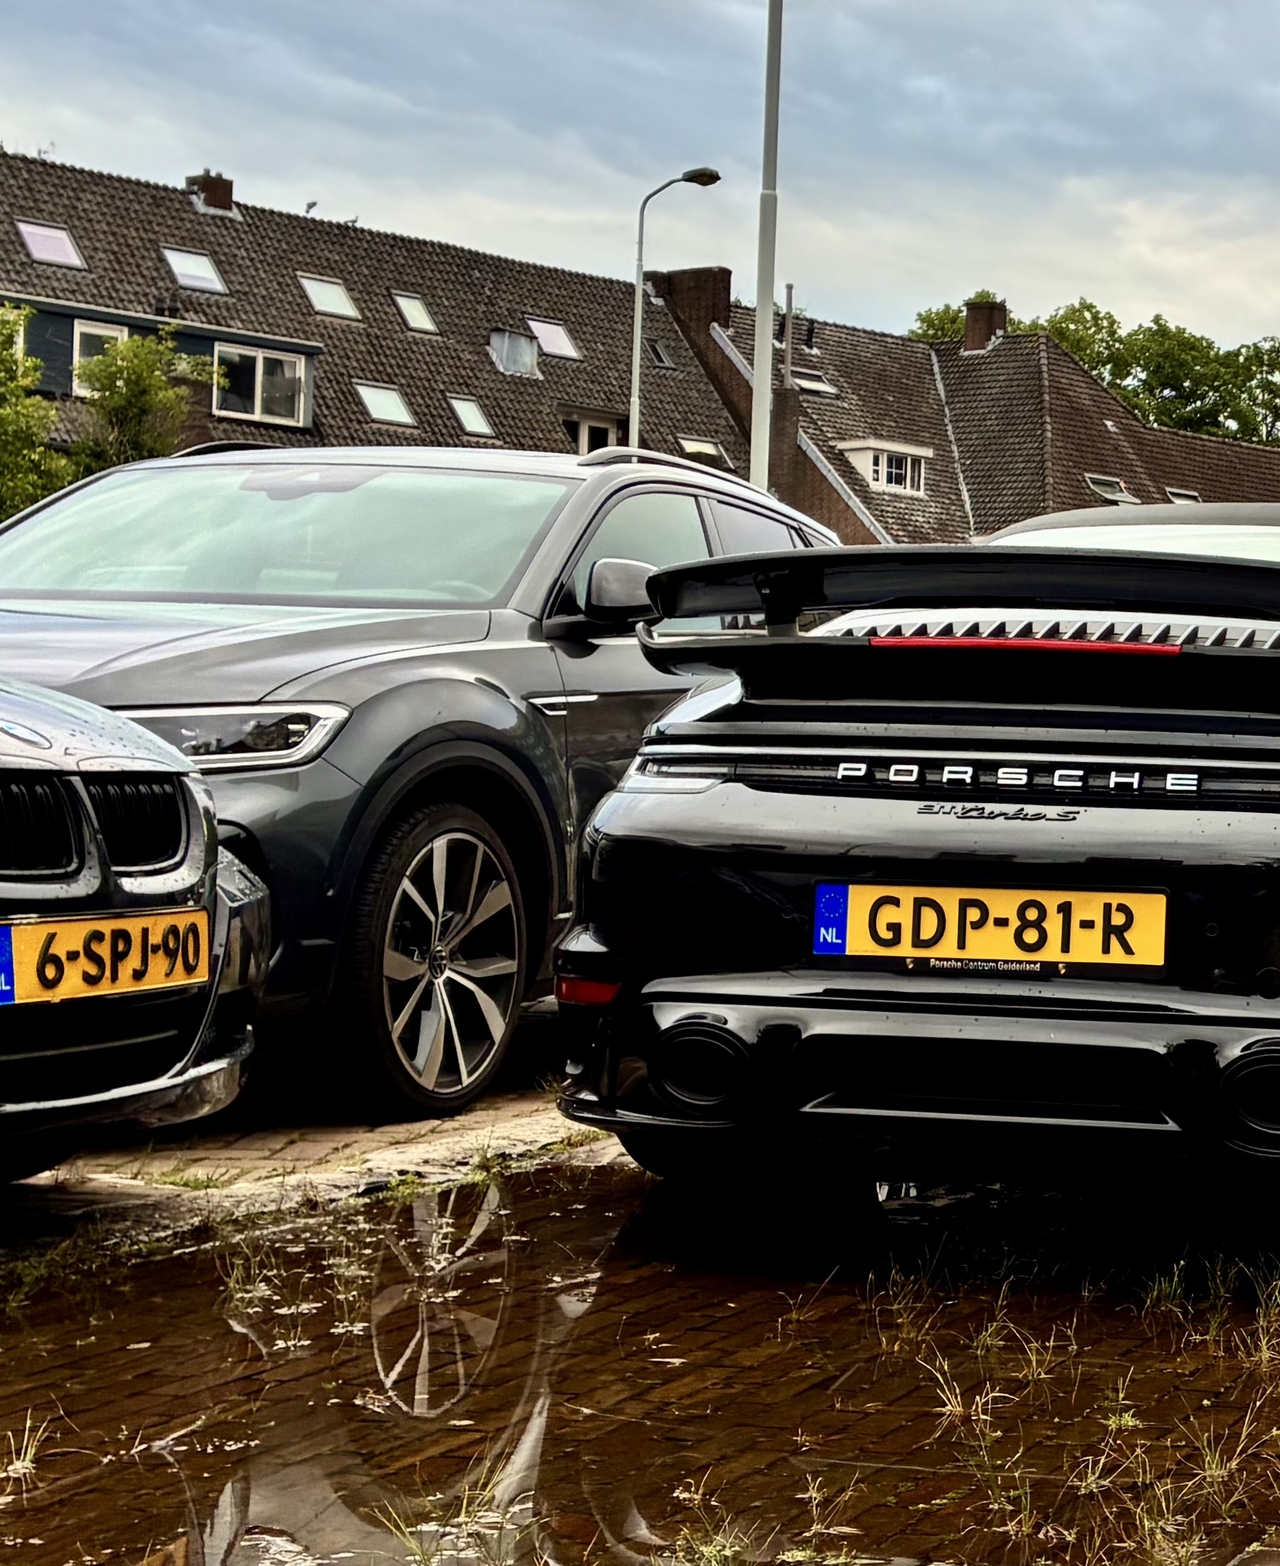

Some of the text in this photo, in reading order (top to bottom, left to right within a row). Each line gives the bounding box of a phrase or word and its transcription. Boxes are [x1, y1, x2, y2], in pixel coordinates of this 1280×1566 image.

[837, 763, 1199, 791] PORSCHE
[819, 926, 842, 943] NL
[868, 895, 1136, 956] GDP-81-R
[36, 921, 200, 990] 6-SPJ-90
[930, 959, 1041, 971] Porsche Centrum Gelderland
[0, 973, 11, 990] L
